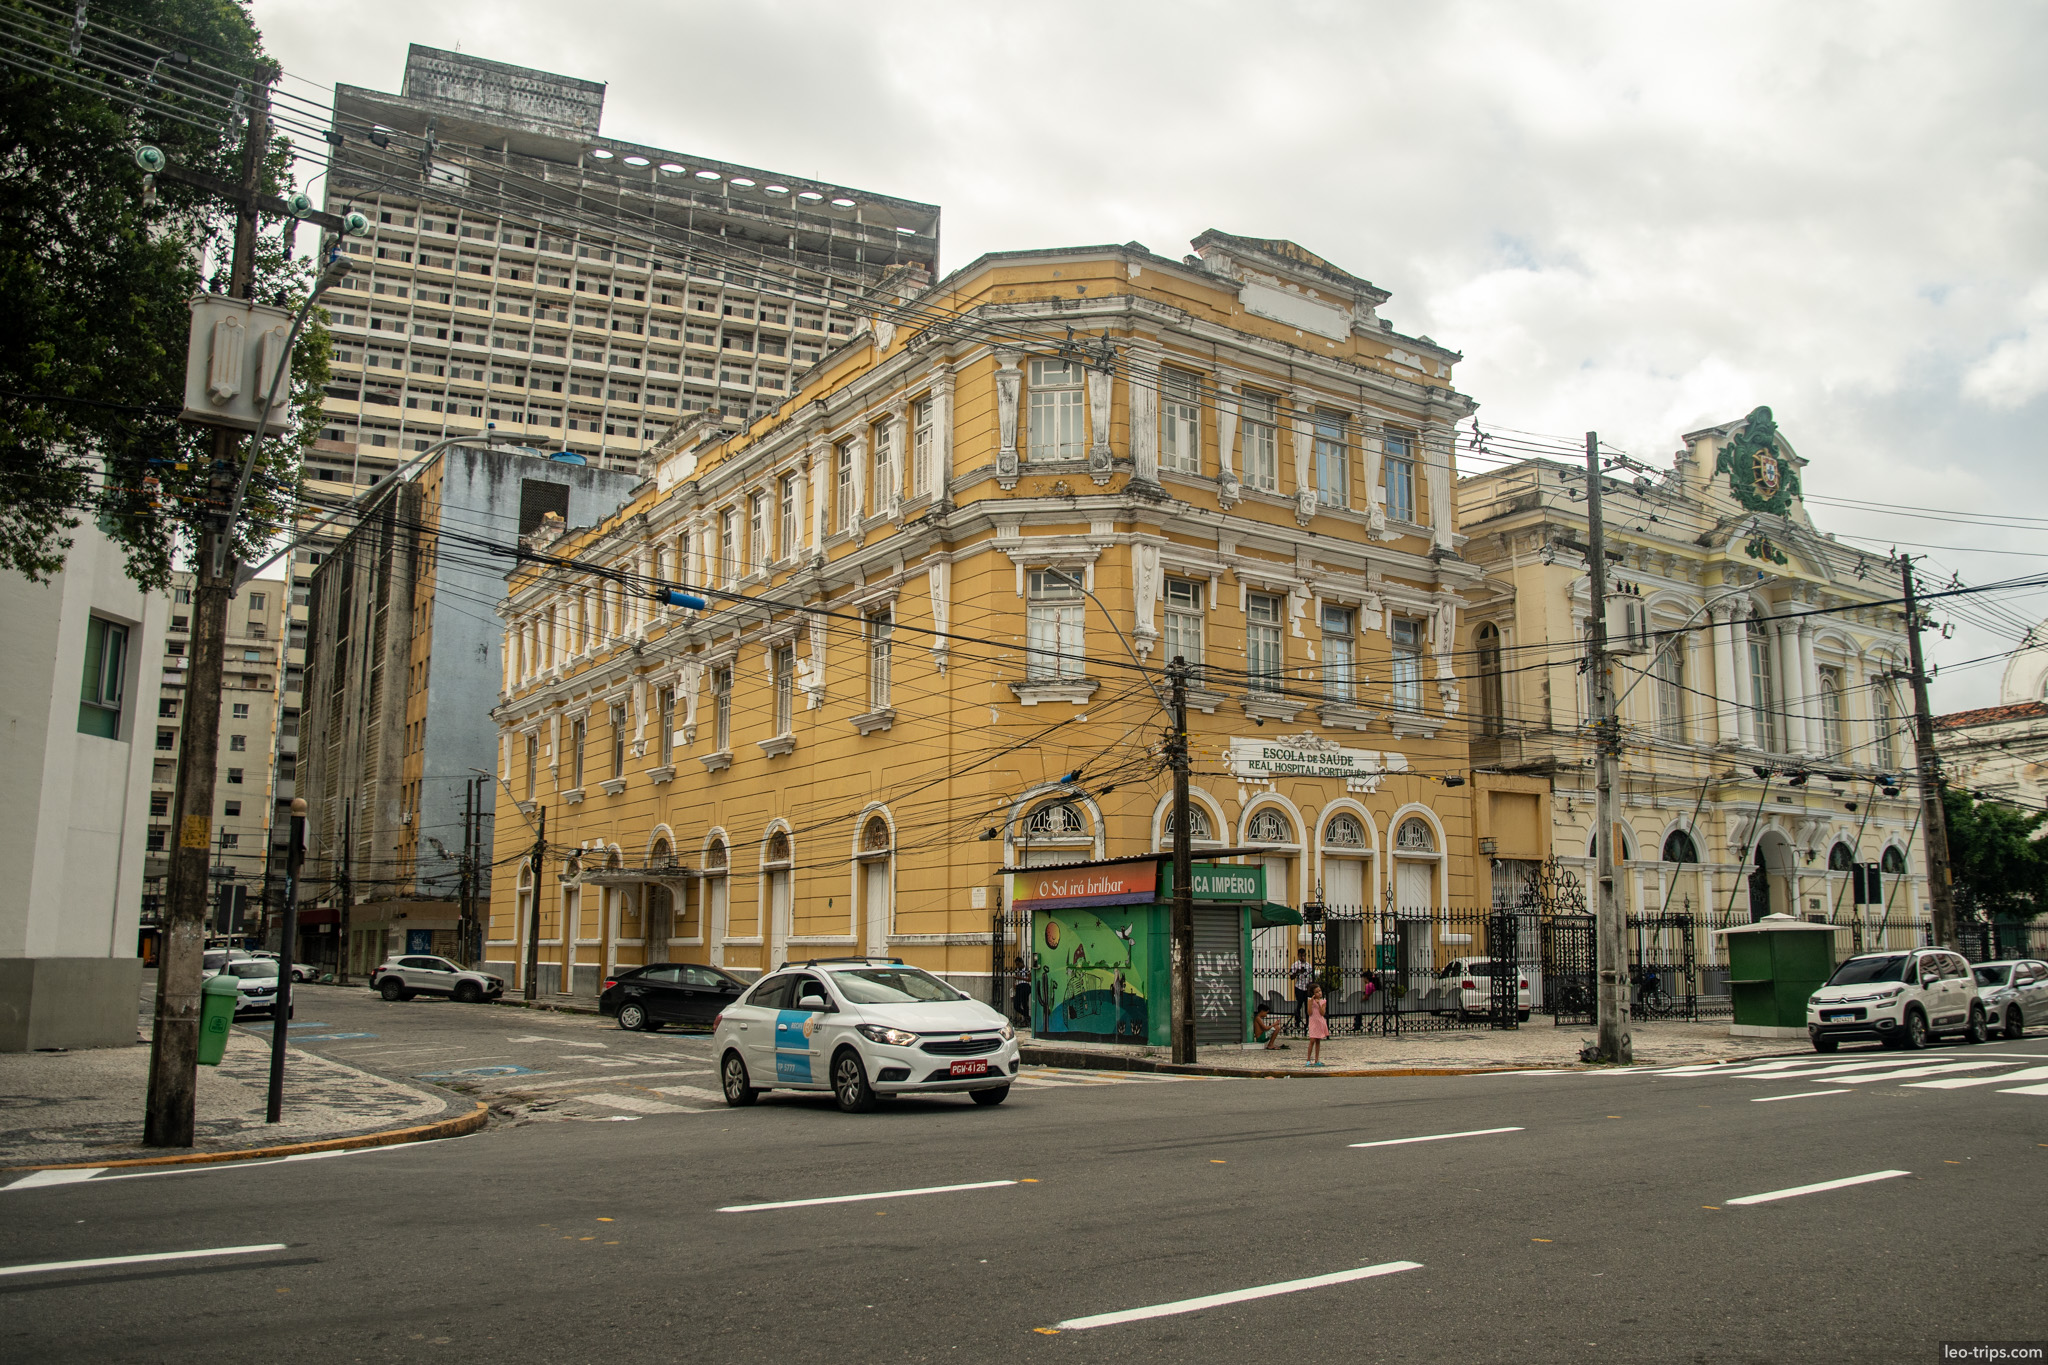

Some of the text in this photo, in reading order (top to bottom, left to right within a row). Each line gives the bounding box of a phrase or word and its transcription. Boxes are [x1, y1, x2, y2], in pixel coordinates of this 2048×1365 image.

[1263, 748, 1305, 762] ESCOLA
[1320, 751, 1354, 767] SAÚDE
[1249, 760, 1367, 780] REAL HOSPITAL PORTUGUÊS
[1039, 875, 1124, 897] O Sol irá brilhar
[1212, 873, 1256, 894] IMPÉRIO
